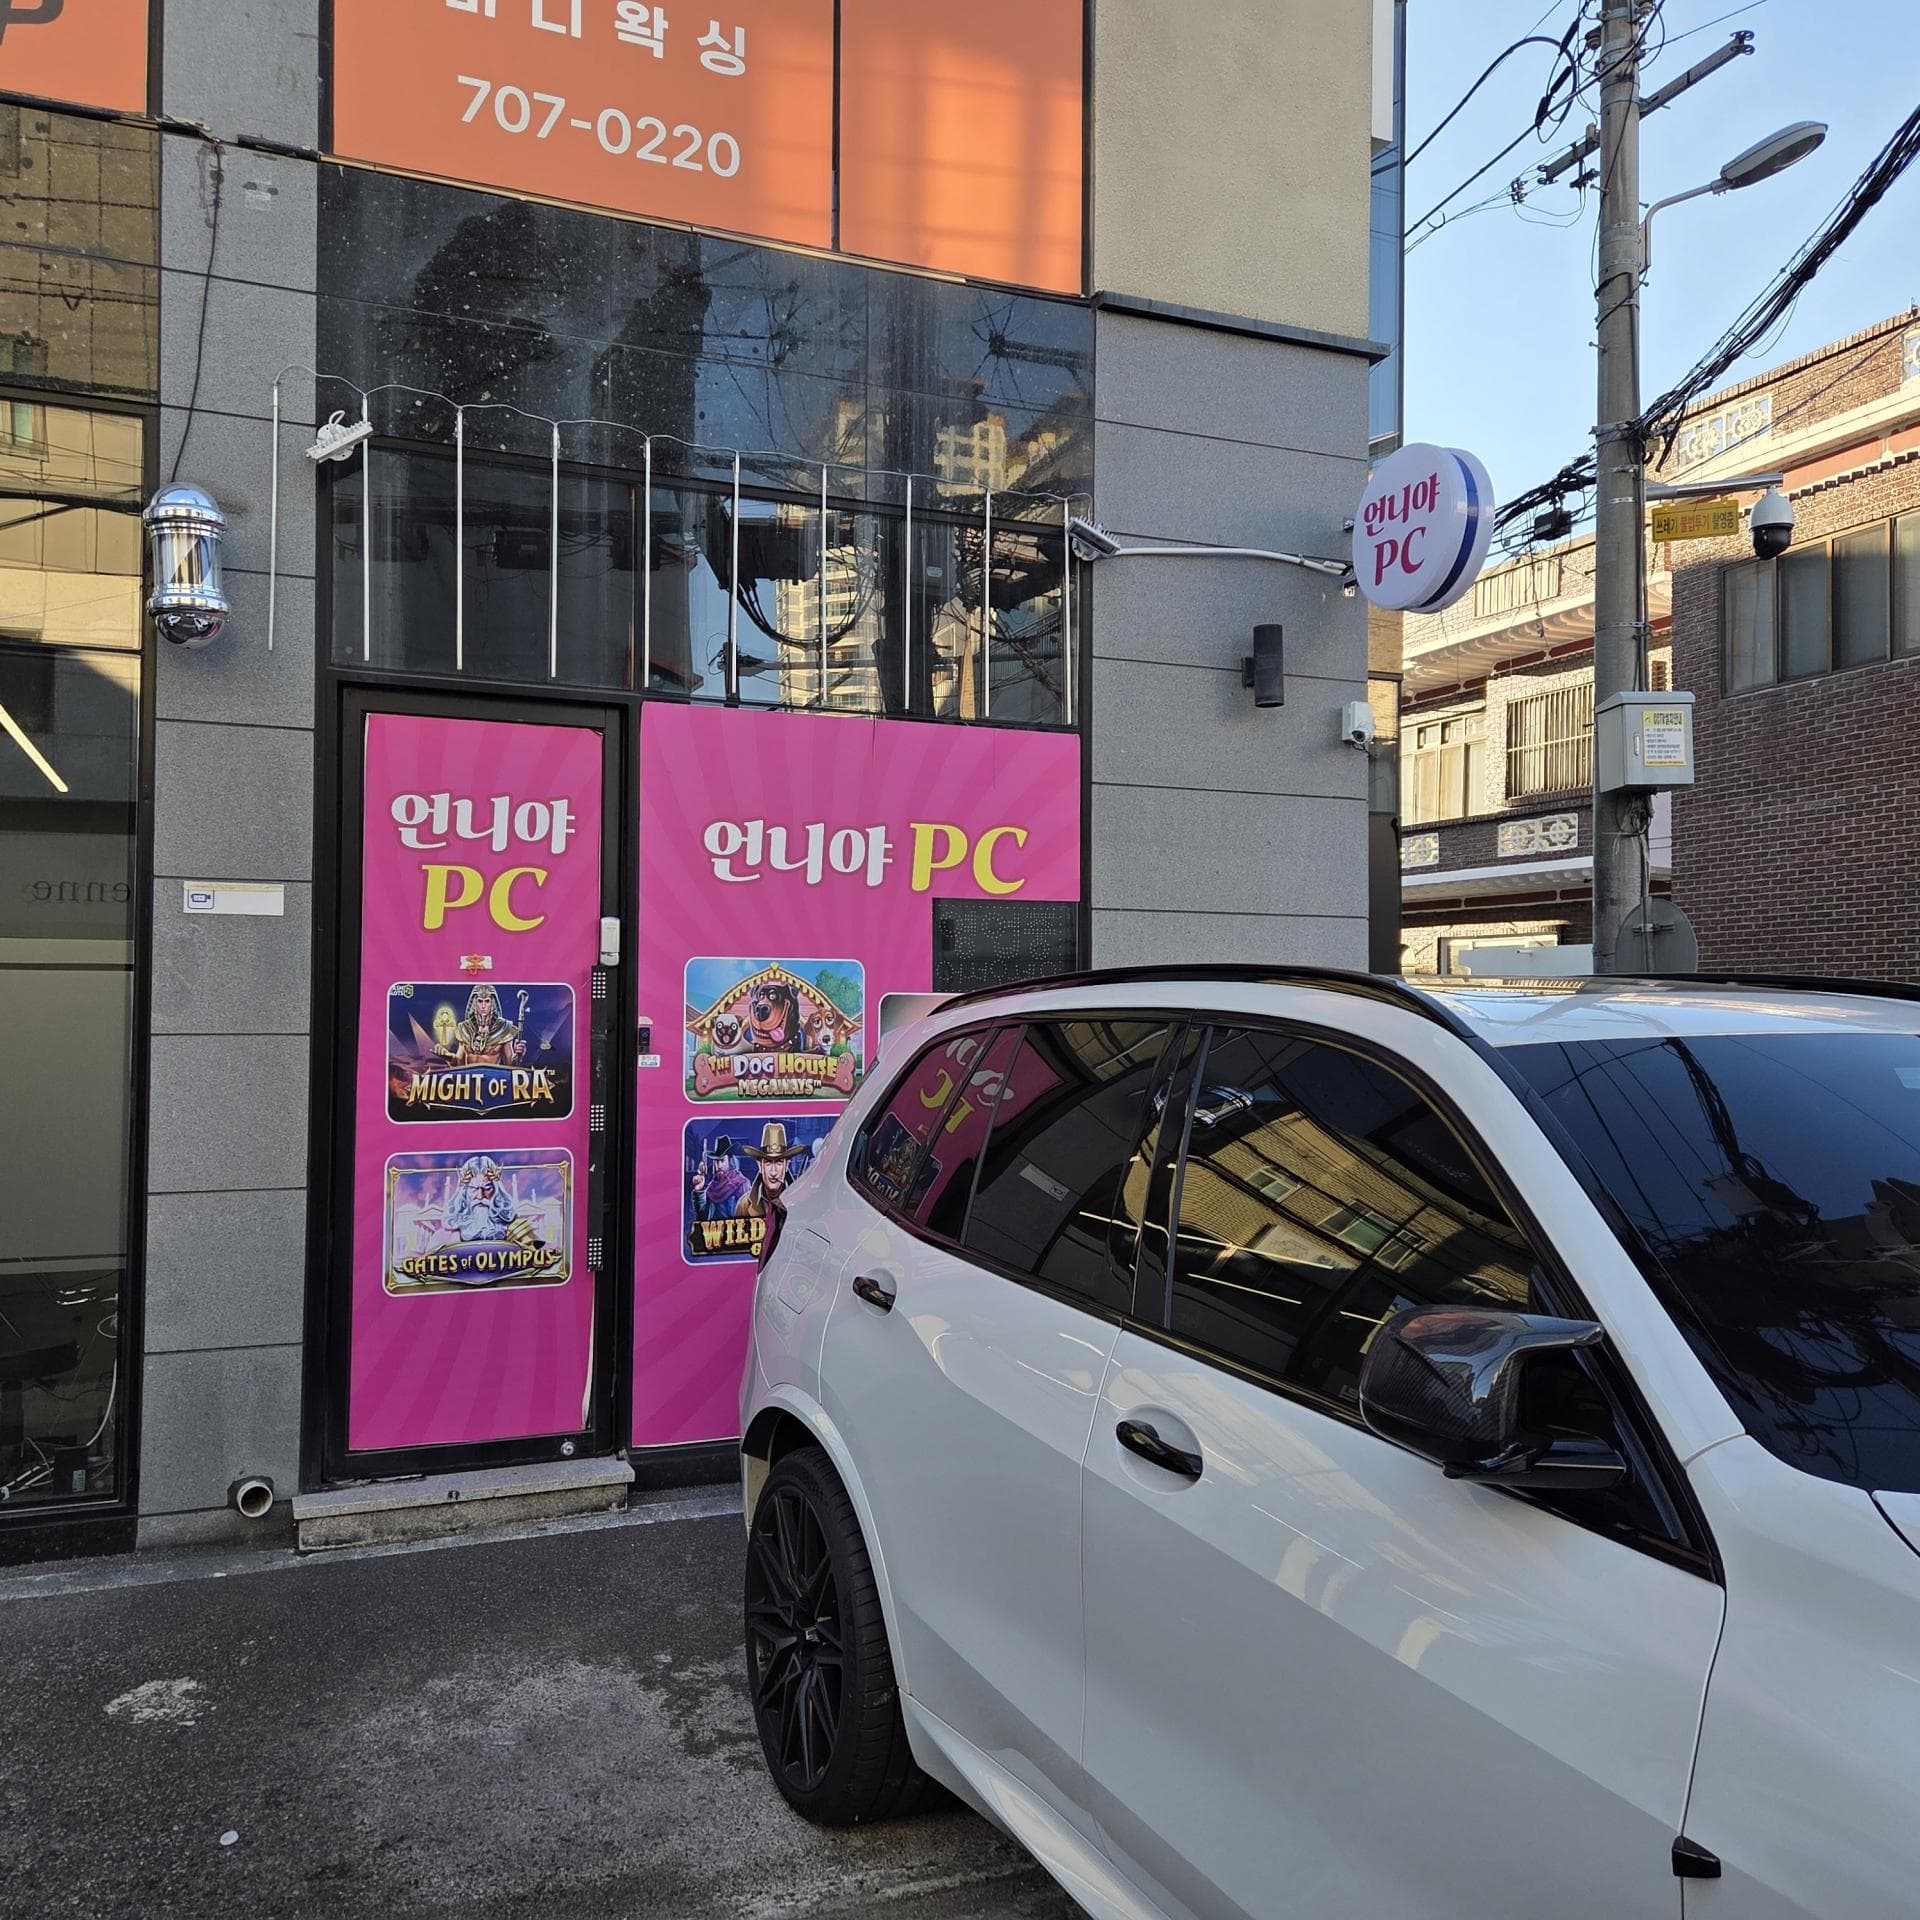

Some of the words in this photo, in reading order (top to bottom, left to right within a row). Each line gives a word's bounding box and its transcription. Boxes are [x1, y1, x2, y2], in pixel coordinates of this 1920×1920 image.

[457, 74, 742, 178] 707-0220
[1363, 472, 1441, 537] 언니야
[1656, 516, 1677, 534] 쓰레기
[1374, 526, 1426, 586] PC
[391, 792, 576, 854] 언니야
[703, 819, 894, 887] 언니야
[909, 822, 1029, 895] PC
[421, 864, 548, 932] PC
[406, 1072, 485, 1106] MIGHT
[488, 1078, 507, 1097] OF
[708, 1055, 731, 1076] THE
[733, 1056, 775, 1077] DOG
[778, 1053, 839, 1079] HOUSE
[402, 1254, 458, 1275] GATES
[475, 1249, 556, 1271] OLYMPUS
[701, 1216, 767, 1250] WILD
